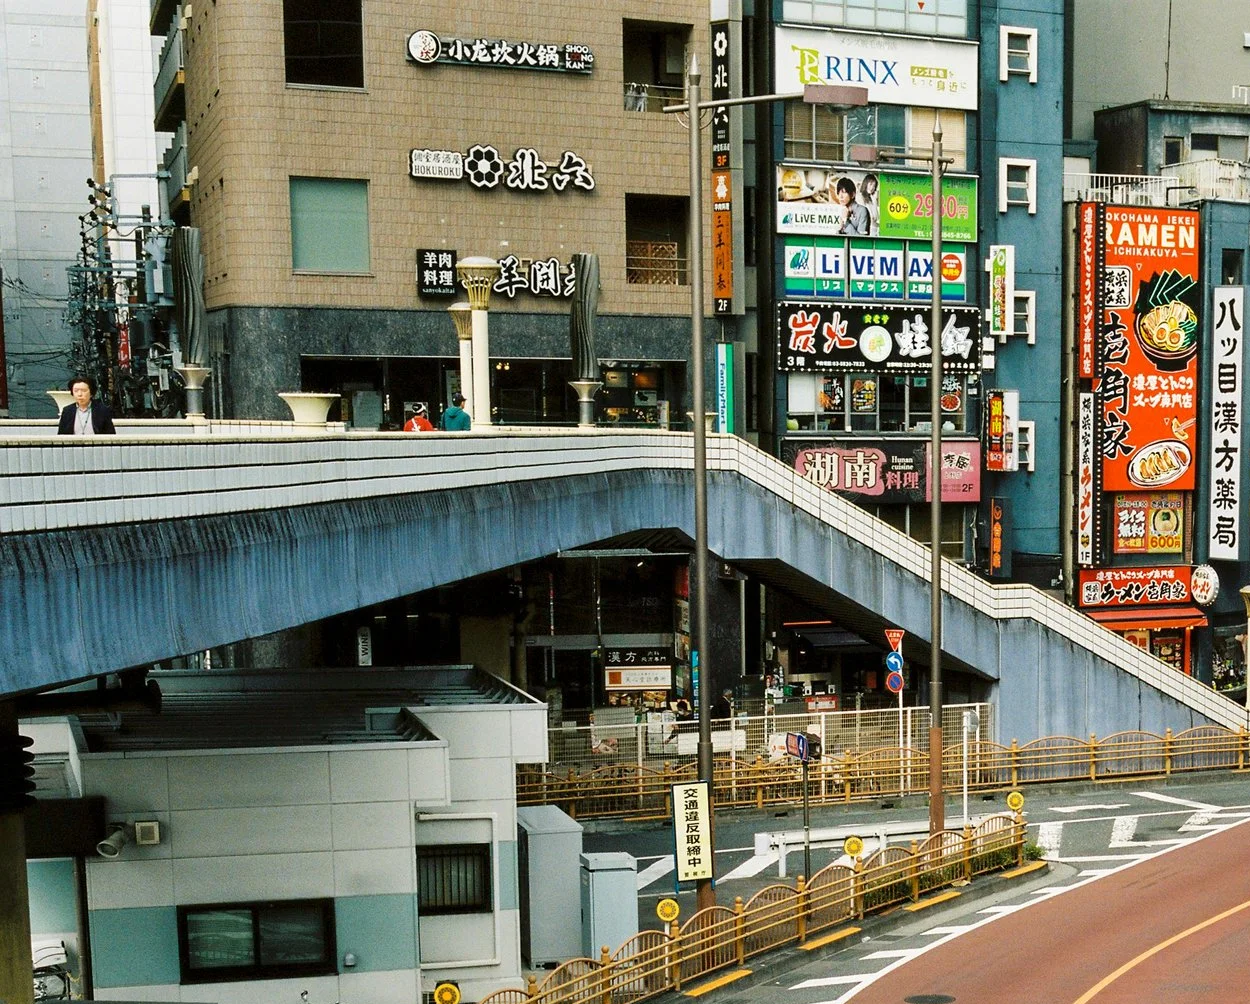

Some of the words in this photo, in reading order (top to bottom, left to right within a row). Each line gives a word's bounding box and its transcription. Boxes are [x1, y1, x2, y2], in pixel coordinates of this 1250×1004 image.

[448, 39, 560, 68] 小龙坎火锅
[566, 45, 588, 53] SHOO
[566, 61, 585, 69] KAN
[824, 55, 900, 86] RINX
[717, 154, 728, 167] 3F
[414, 165, 462, 177] HOKUROKU
[889, 202, 909, 215] 60分
[818, 214, 840, 225] MAX
[1104, 212, 1159, 224] OKOHAMA
[1167, 215, 1195, 225] IEKEI
[1105, 222, 1195, 249] RAMEN
[1113, 246, 1178, 258] ICHIKAKUYA
[424, 252, 452, 268] 羊肉
[424, 270, 453, 286] 料理
[718, 299, 728, 312] 2F
[788, 310, 857, 354] 炭火
[787, 357, 805, 366] 3階
[1132, 374, 1194, 391] 濃厚とんこつ
[1132, 393, 1193, 409] スープ専門店
[891, 455, 913, 464] Hunan
[803, 450, 879, 490] 湖南
[885, 471, 919, 490] 料理
[961, 484, 974, 493] 2F
[1118, 510, 1146, 523] ライス
[1118, 523, 1146, 537] 無料
[1150, 536, 1181, 548] 600円
[1080, 551, 1090, 562] 1F
[1100, 580, 1187, 603] ラーメン壱角家
[608, 651, 637, 662] 漢方
[683, 788, 702, 867] 交通違反取締中
